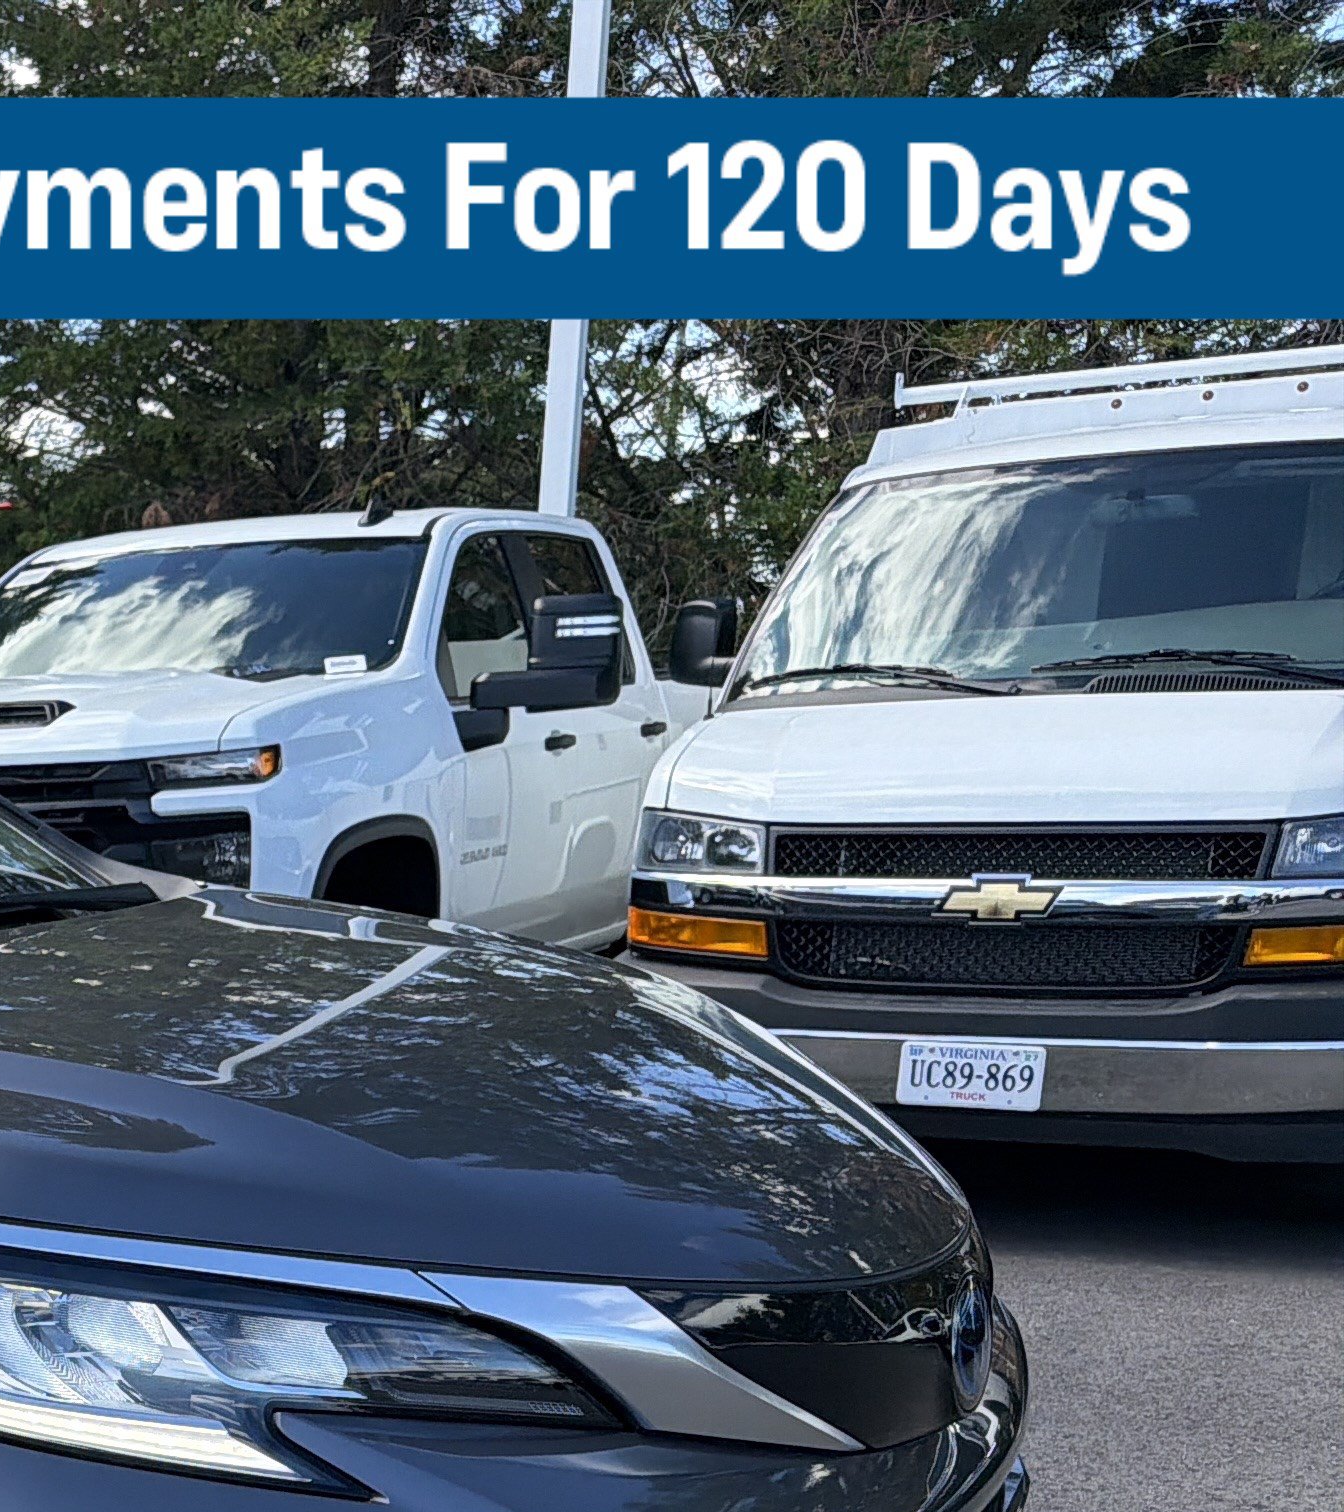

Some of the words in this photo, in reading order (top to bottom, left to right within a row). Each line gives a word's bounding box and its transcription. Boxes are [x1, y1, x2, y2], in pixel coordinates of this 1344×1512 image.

[938, 1046, 1007, 1061] VIRGINIA
[910, 1058, 1035, 1093] UC89-869
[949, 1091, 986, 1101] TRUCK
